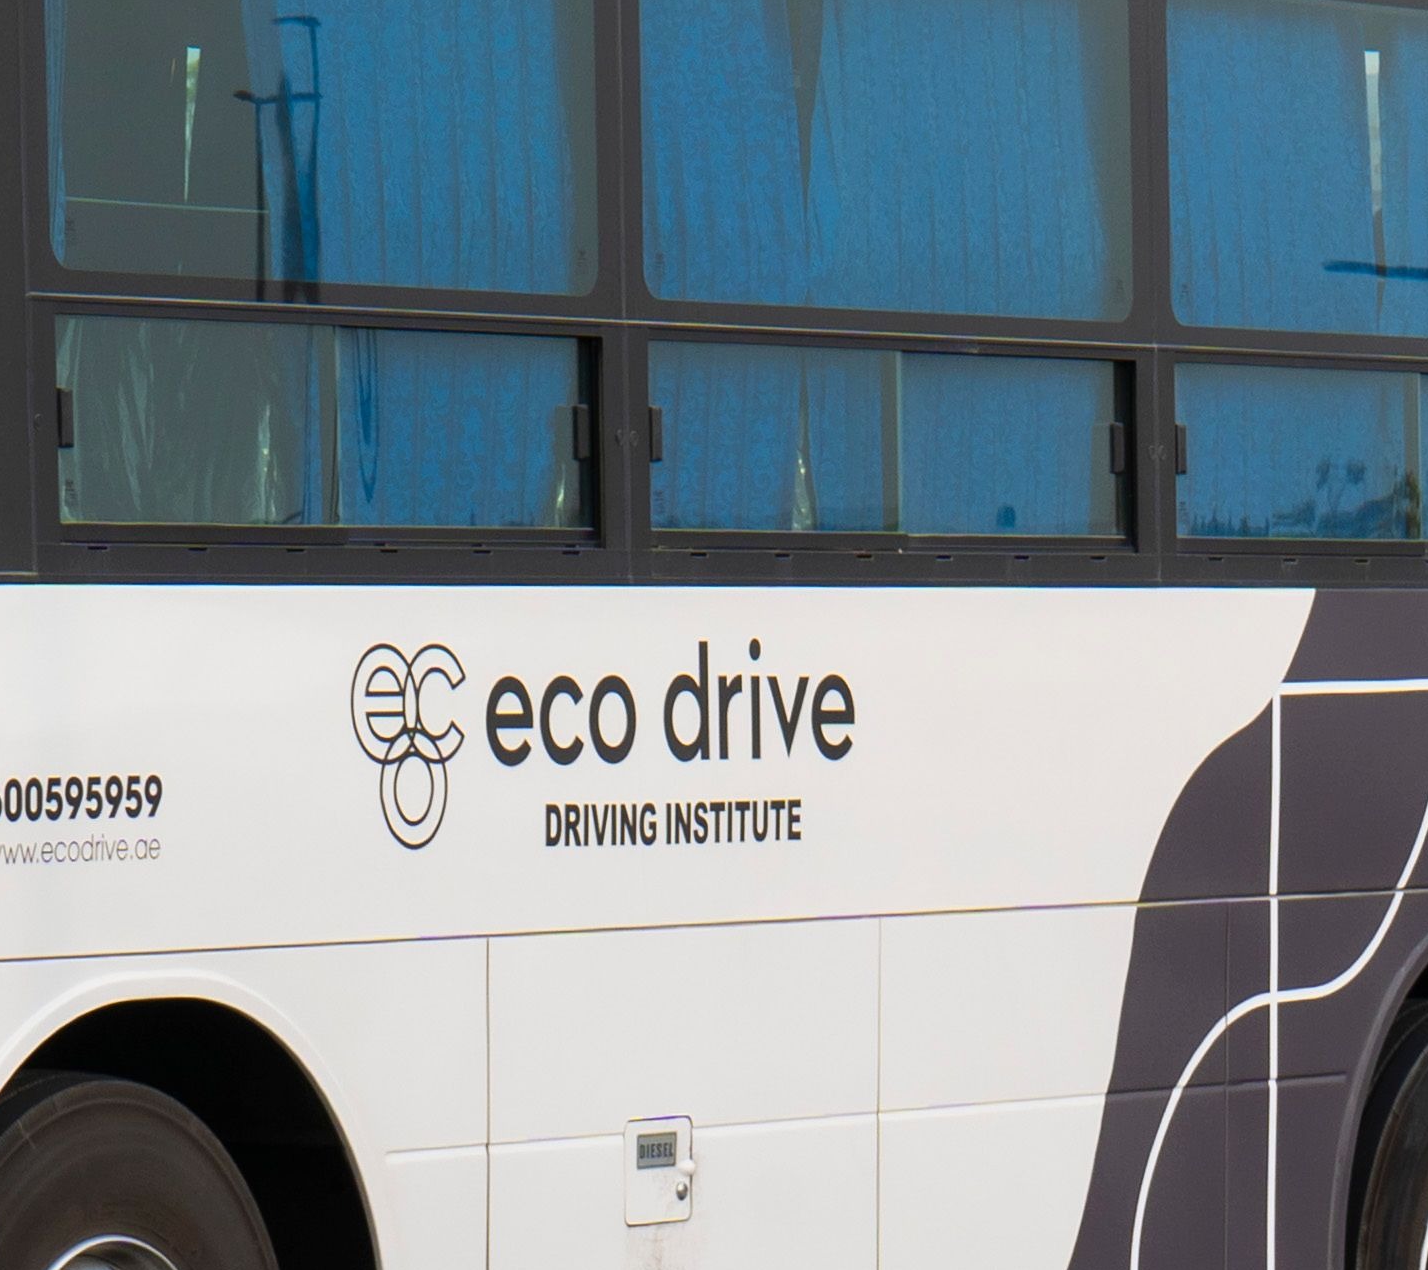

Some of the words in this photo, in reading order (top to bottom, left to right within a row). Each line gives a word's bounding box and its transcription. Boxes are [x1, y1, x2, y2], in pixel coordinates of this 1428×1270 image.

[485, 675, 637, 767] eco
[663, 638, 855, 763] drive
[545, 802, 657, 847] DRIVING
[666, 799, 802, 845] INSTITUTE
[639, 1142, 674, 1160] DIESEL
